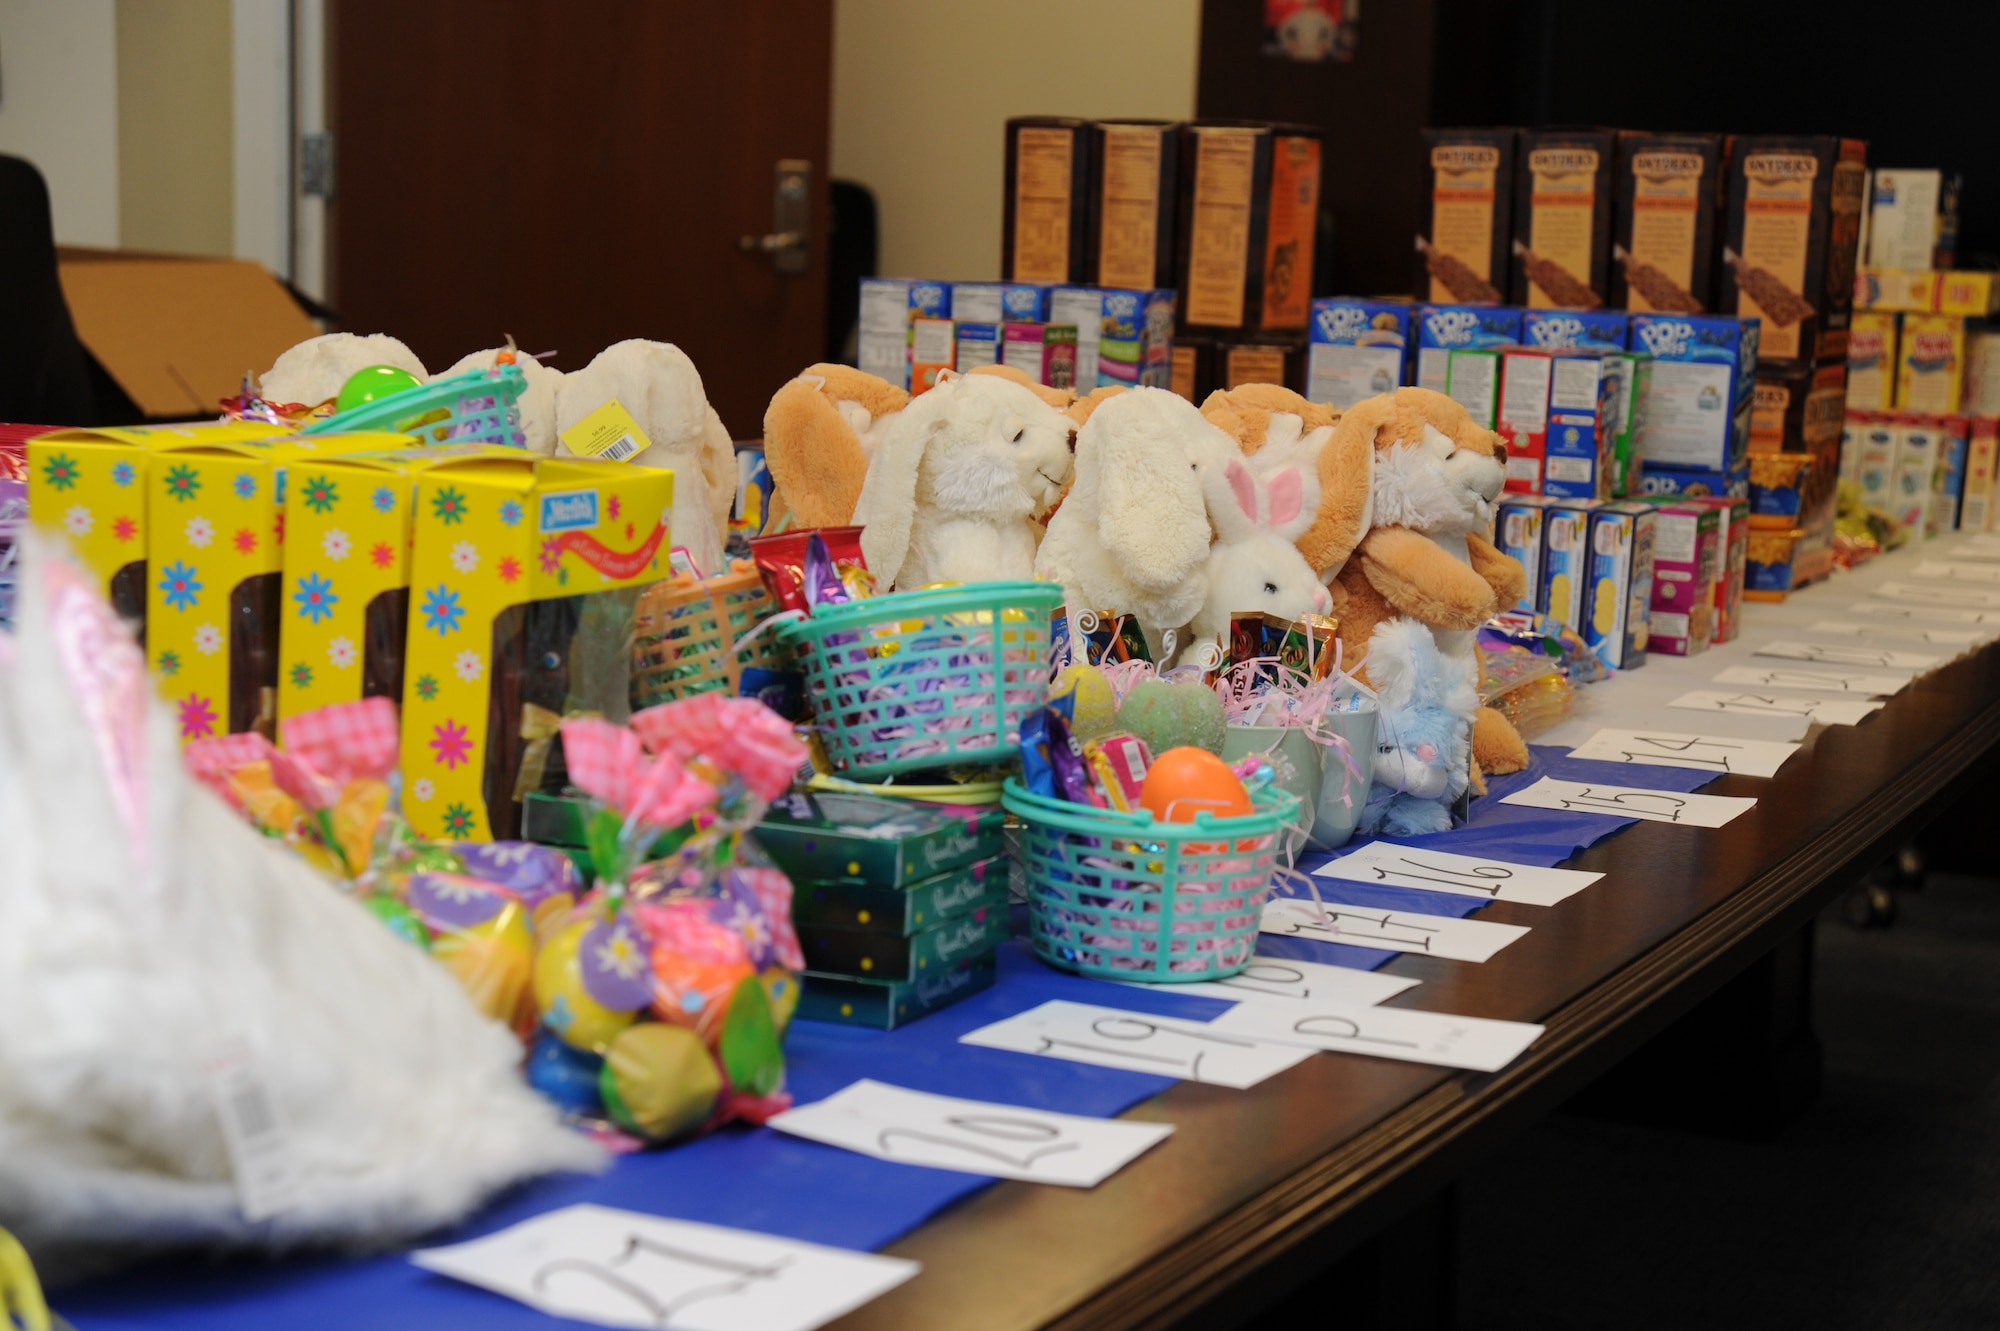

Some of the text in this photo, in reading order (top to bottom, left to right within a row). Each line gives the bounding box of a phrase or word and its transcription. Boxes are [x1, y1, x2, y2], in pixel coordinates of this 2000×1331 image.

[1620, 736, 1745, 771] 14
[1560, 787, 1687, 822] 15
[1372, 857, 1514, 897] 16
[1285, 911, 1441, 952] 17
[1036, 1014, 1257, 1082] 19
[878, 1114, 1082, 1169] 20
[533, 1234, 798, 1328] 21
